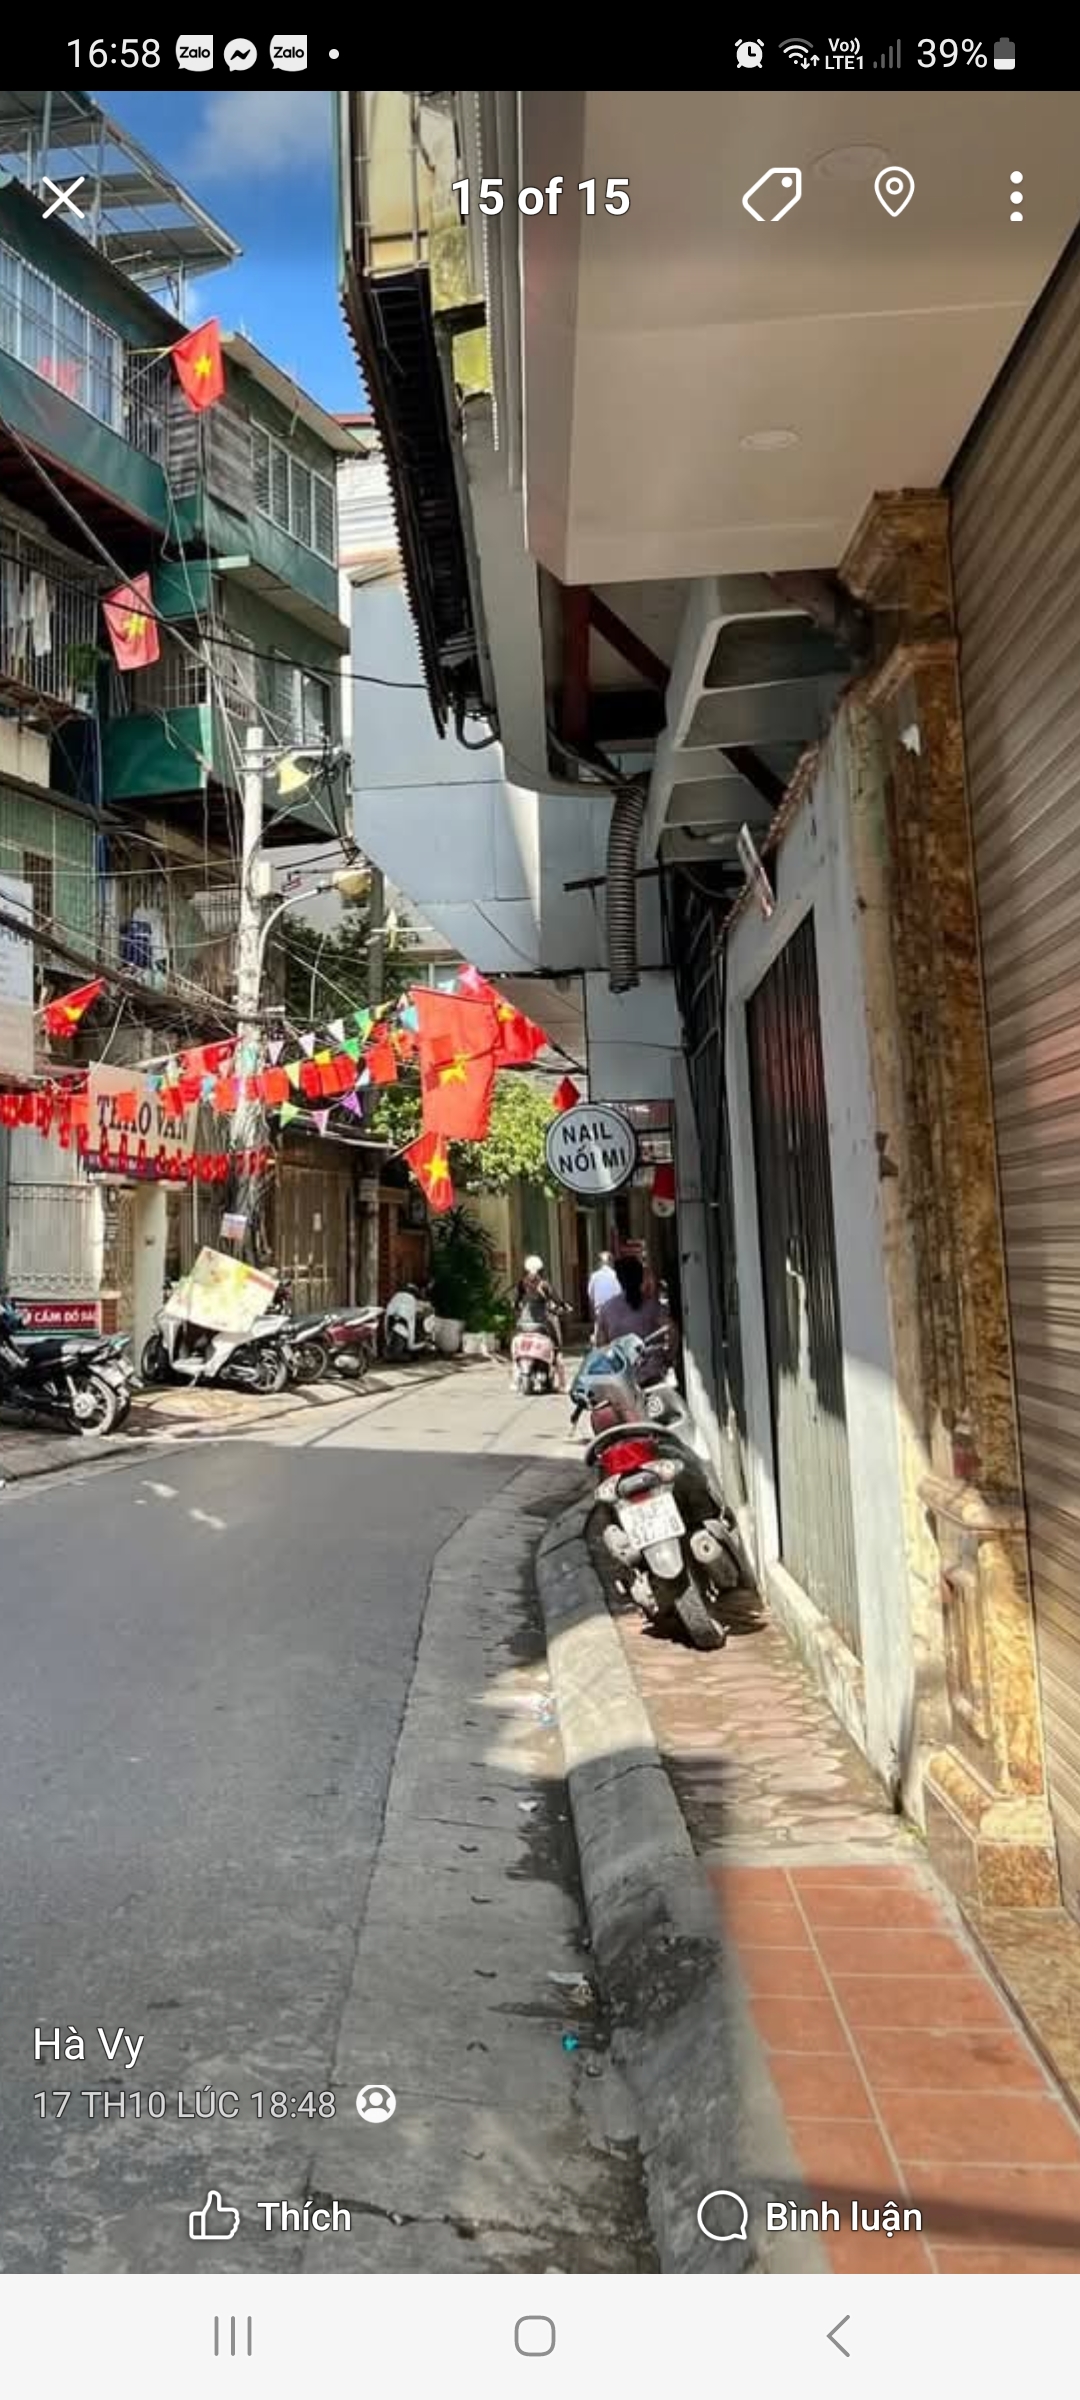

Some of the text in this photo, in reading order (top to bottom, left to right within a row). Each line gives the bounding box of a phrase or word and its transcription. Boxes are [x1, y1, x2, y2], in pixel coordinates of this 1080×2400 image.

[562, 1122, 613, 1145] NAIL
[558, 1144, 597, 1174] NỐI
[602, 1147, 626, 1169] MI
